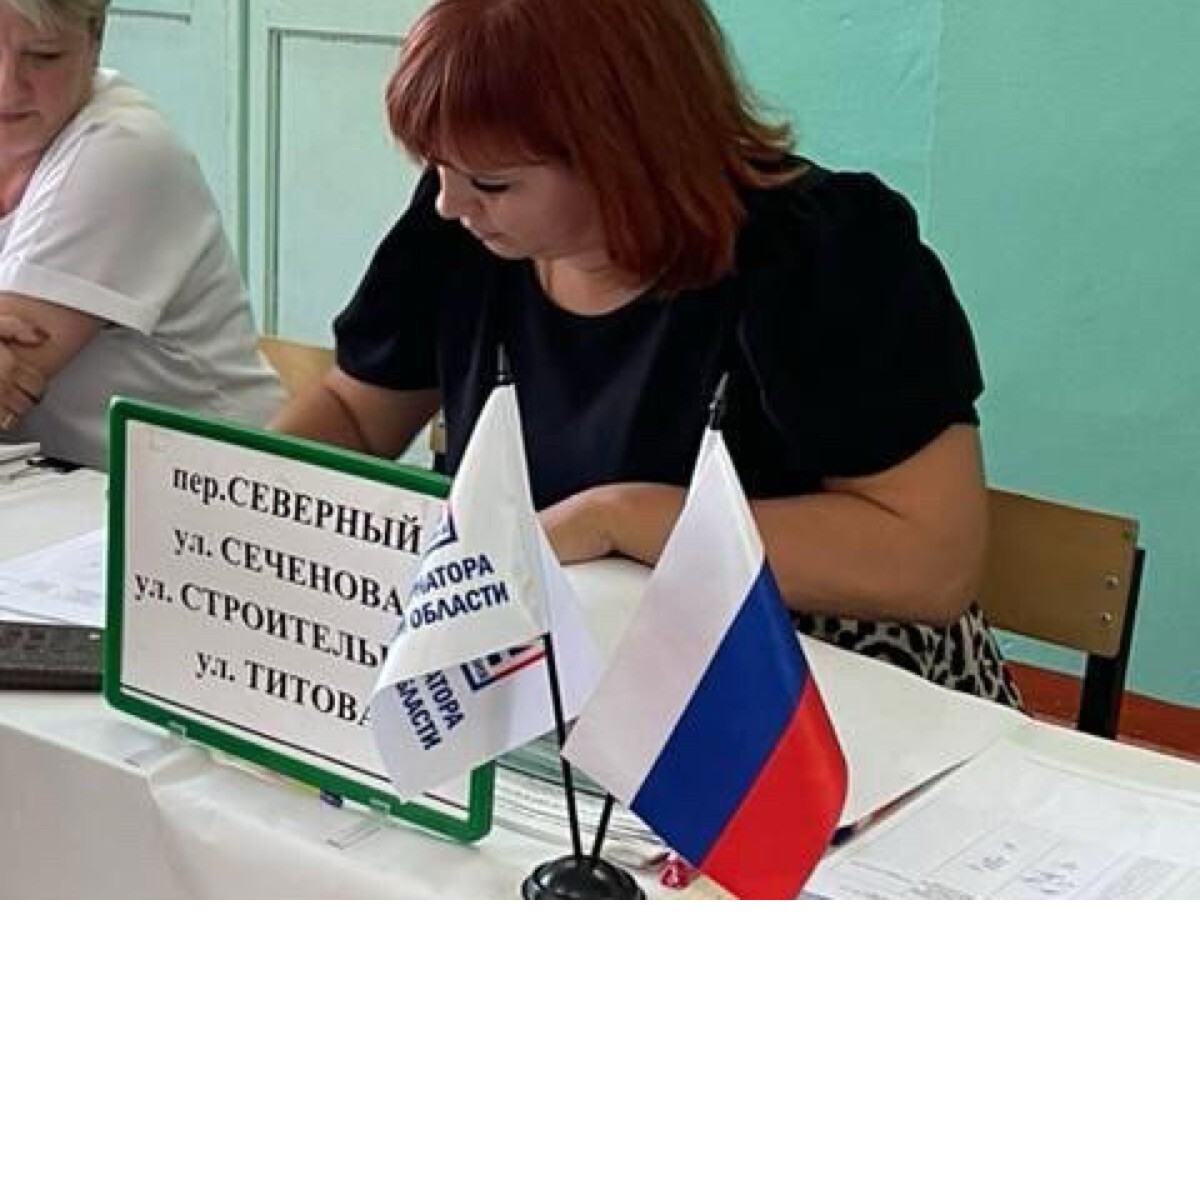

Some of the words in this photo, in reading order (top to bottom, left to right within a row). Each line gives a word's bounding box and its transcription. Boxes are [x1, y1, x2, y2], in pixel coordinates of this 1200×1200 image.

[172, 466, 422, 555] пер.СЕВЕРНЫЙ
[173, 528, 213, 556] ул.
[221, 535, 403, 616] СЕЧЕНОВА
[409, 580, 510, 629] ОБЛАСТИ
[134, 574, 174, 602] ул.
[181, 582, 389, 668] СТРОИТЕЛЬ
[195, 652, 236, 681] ул.
